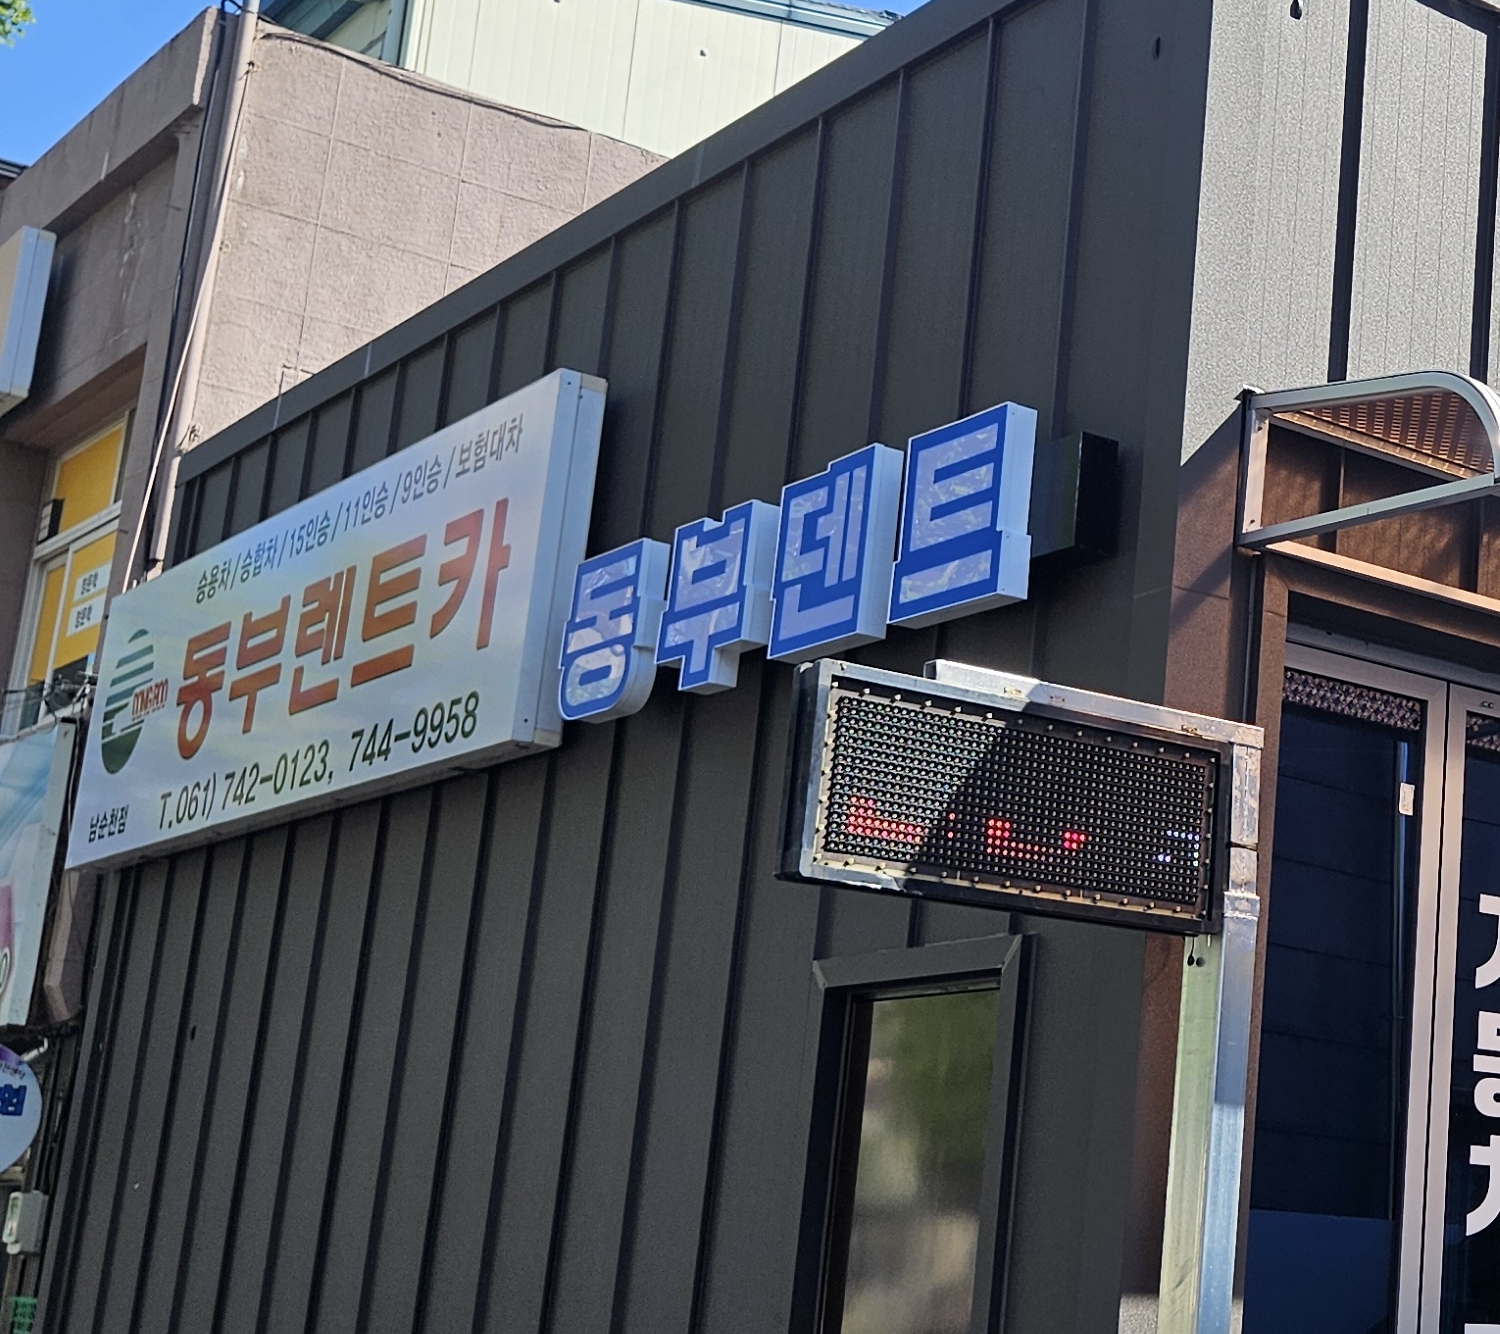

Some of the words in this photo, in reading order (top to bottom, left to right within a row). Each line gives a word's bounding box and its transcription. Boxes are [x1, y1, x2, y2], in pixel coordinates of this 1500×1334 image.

[176, 497, 512, 760] 동부렌트카
[559, 402, 1010, 721] 동부덴트
[348, 689, 480, 772] 744-9958
[88, 803, 129, 843] 남순천점
